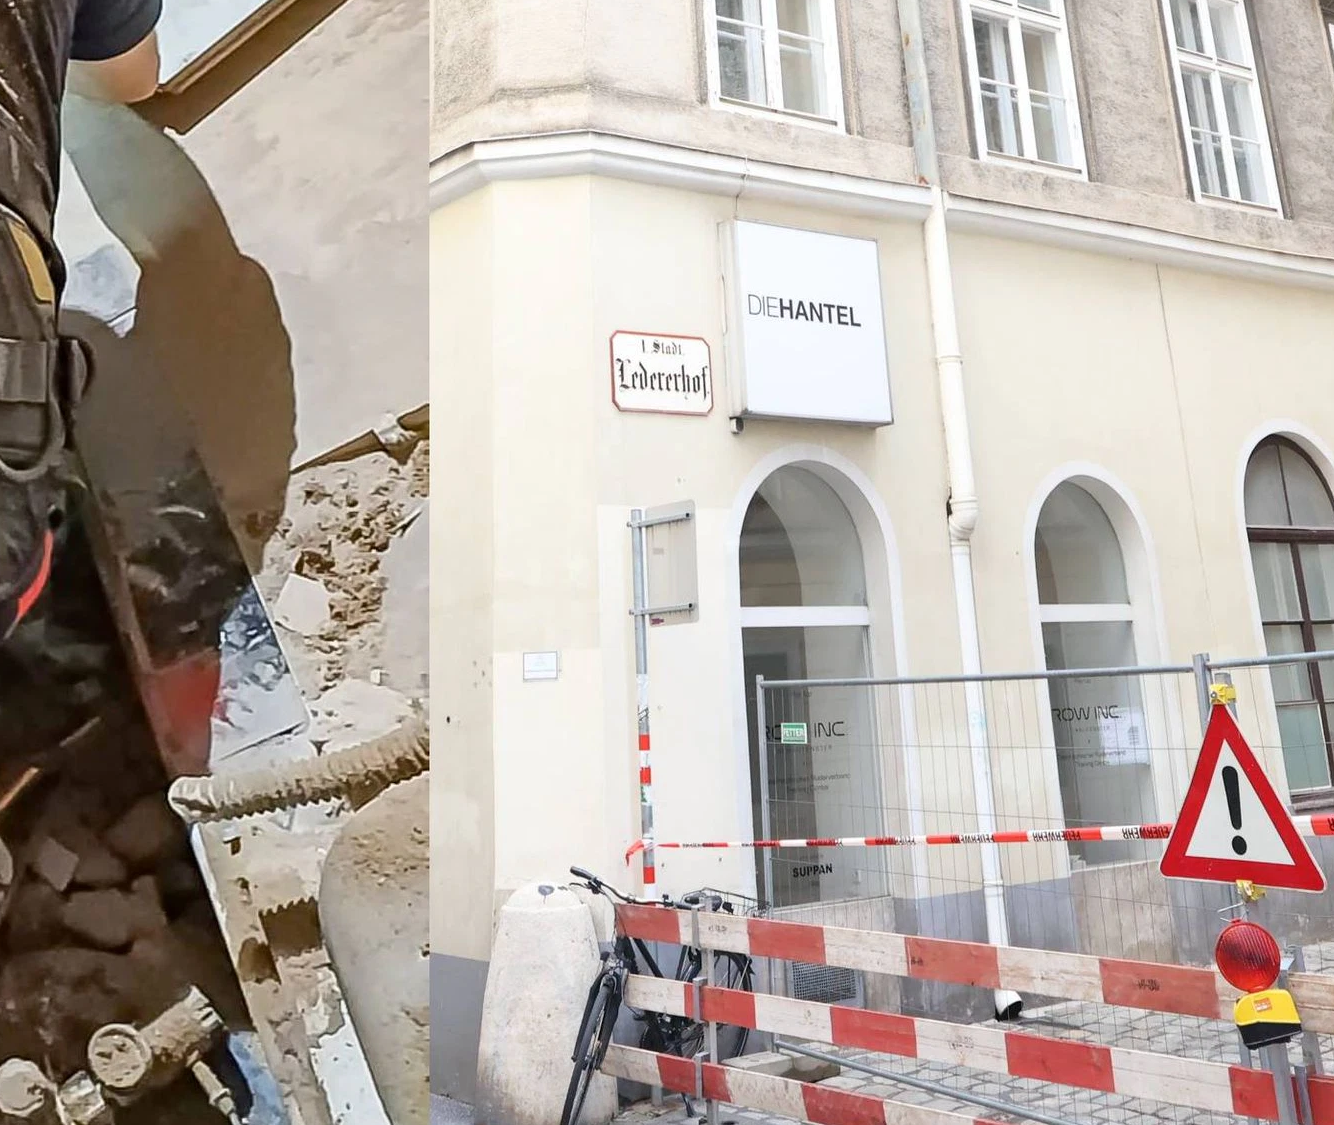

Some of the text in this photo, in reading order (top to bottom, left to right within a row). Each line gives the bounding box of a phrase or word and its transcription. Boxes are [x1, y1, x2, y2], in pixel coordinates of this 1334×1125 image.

[747, 293, 862, 328] DIEHANTEL
[1122, 825, 1170, 840] EUERWEHR
[792, 863, 833, 878] SUPPAN
